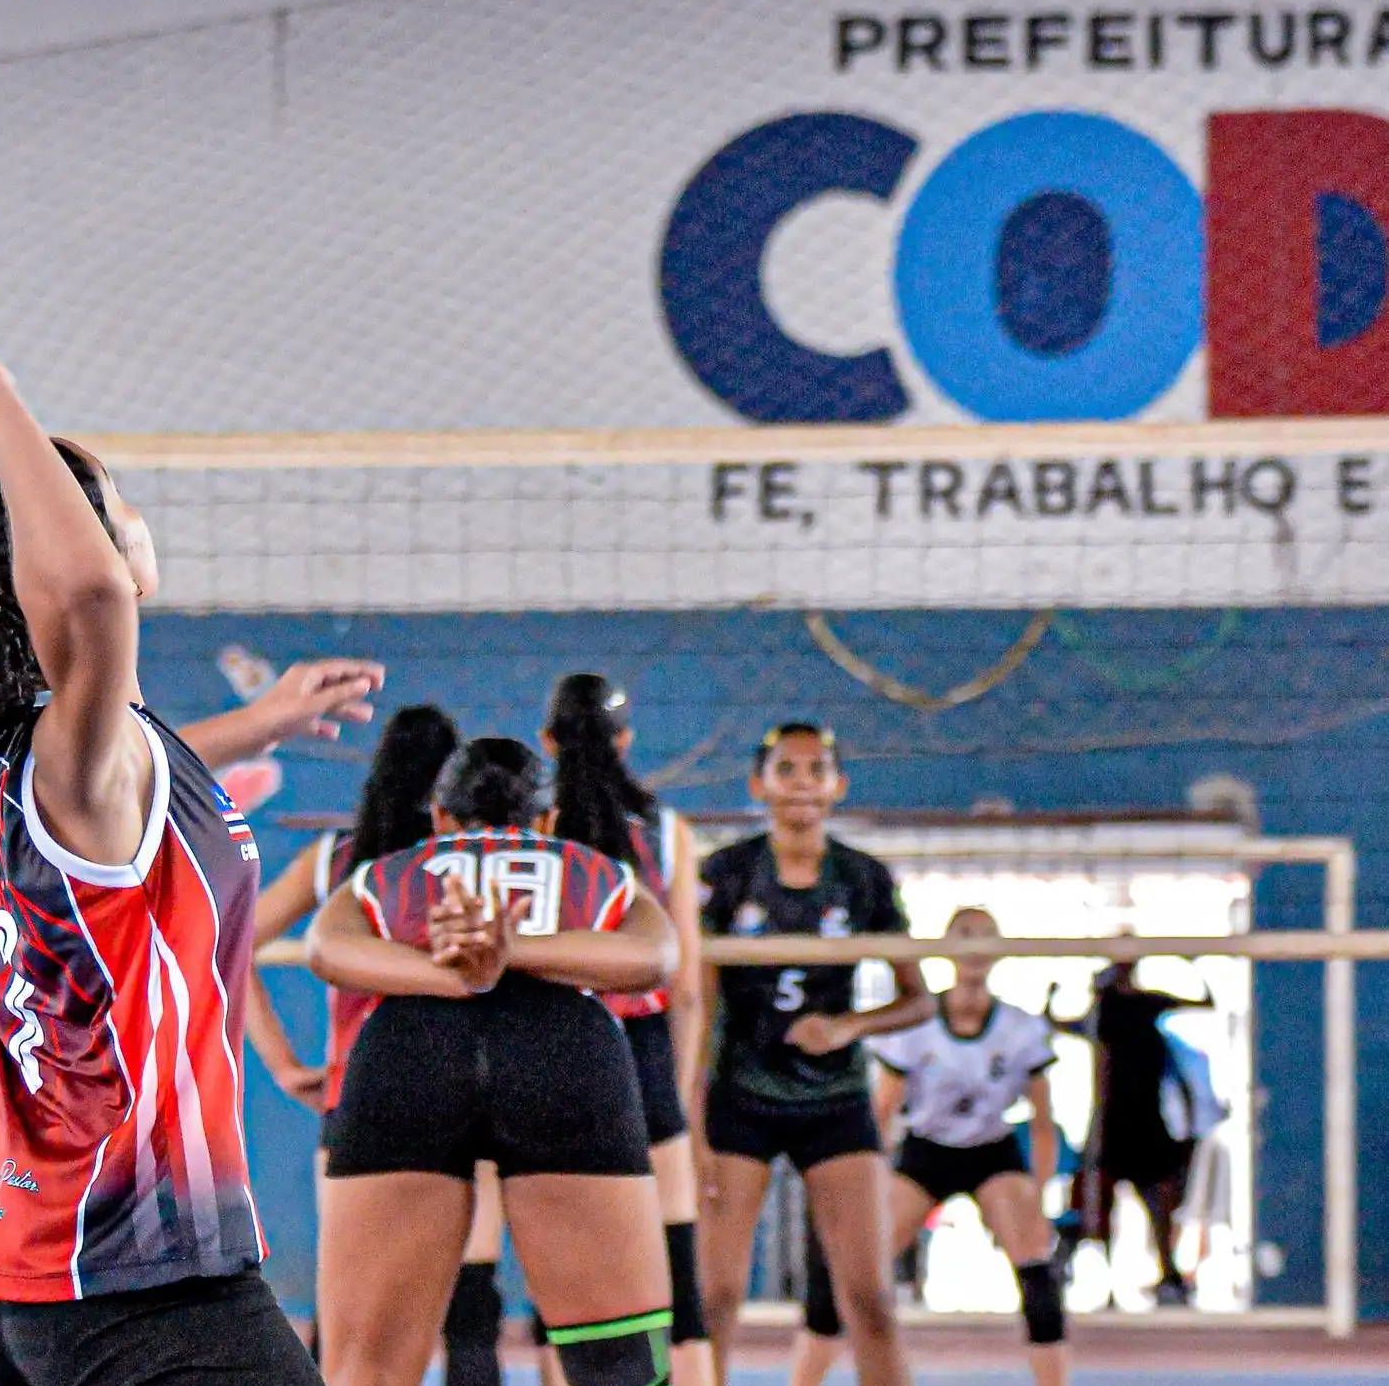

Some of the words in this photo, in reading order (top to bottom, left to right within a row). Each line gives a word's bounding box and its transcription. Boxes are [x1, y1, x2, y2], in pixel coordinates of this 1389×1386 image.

[656, 109, 1389, 425] COD
[859, 459, 1297, 516] TRABALHO
[1338, 458, 1372, 514] E
[774, 969, 807, 1012] 5
